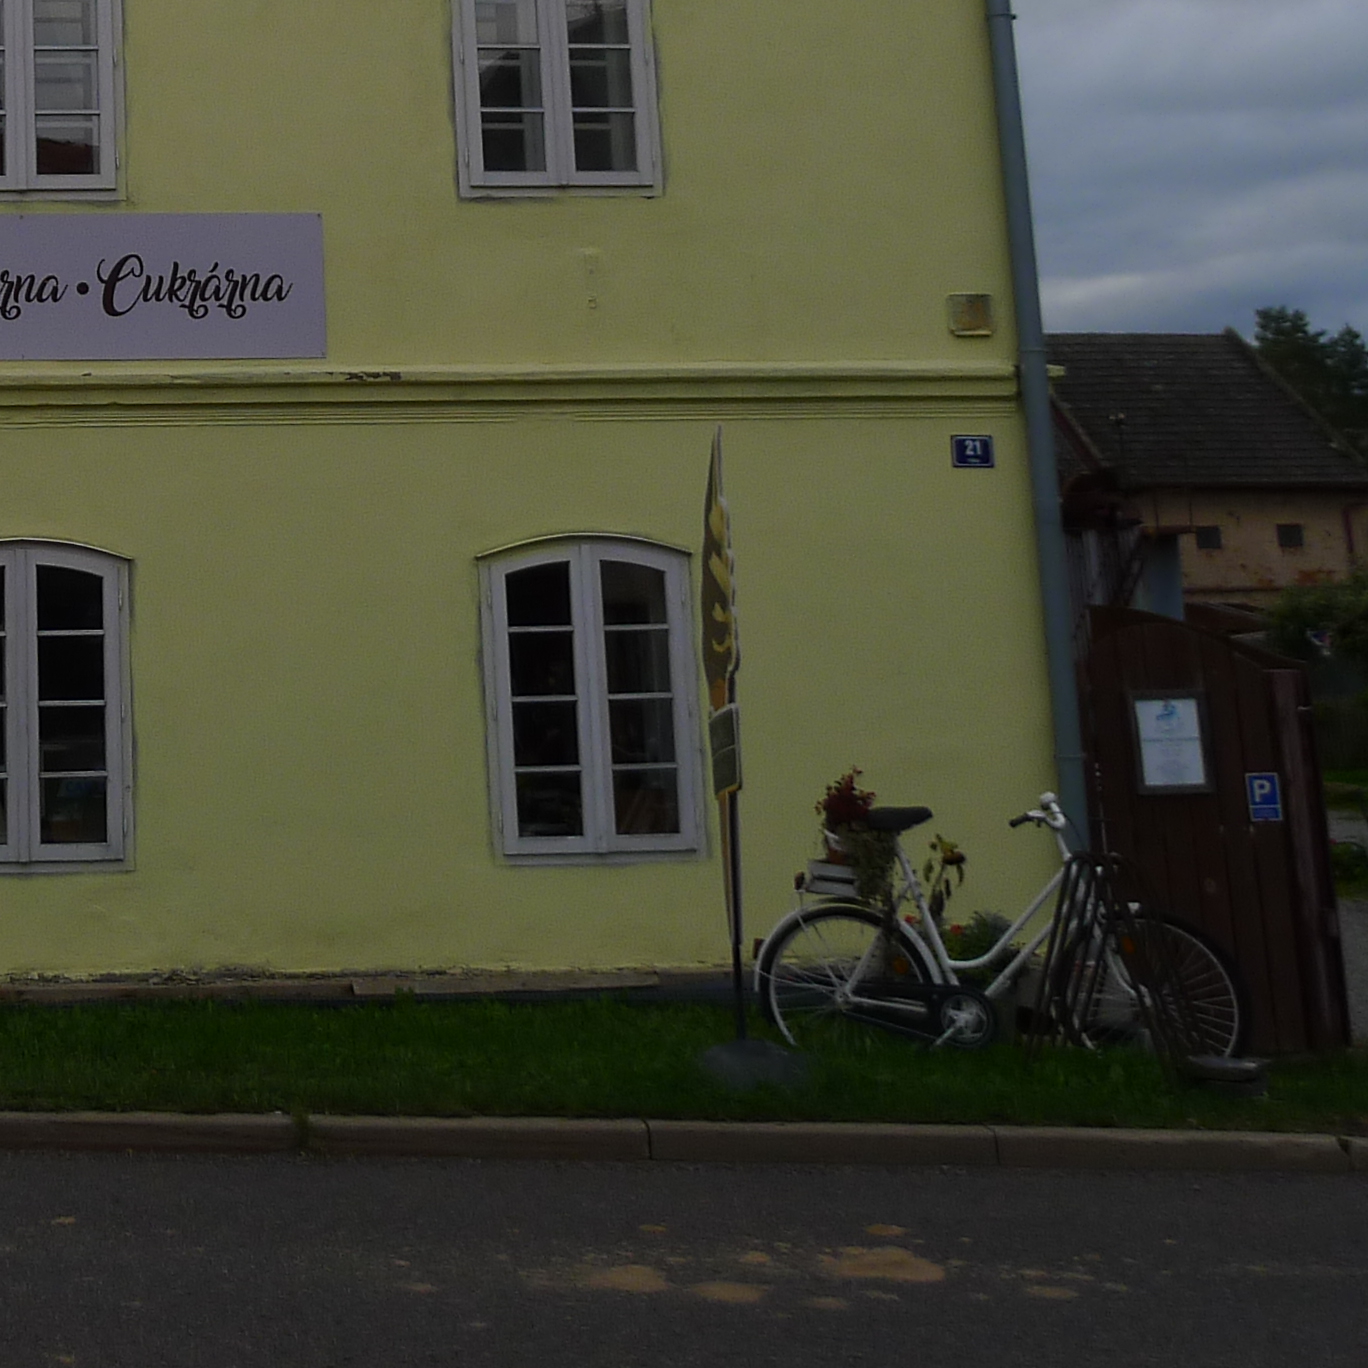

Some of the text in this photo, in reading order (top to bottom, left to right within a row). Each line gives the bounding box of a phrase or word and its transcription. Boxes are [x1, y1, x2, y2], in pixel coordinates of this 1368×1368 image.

[97, 253, 293, 319] Cukrárna
[964, 439, 982, 455] 21
[1253, 779, 1271, 803] P
